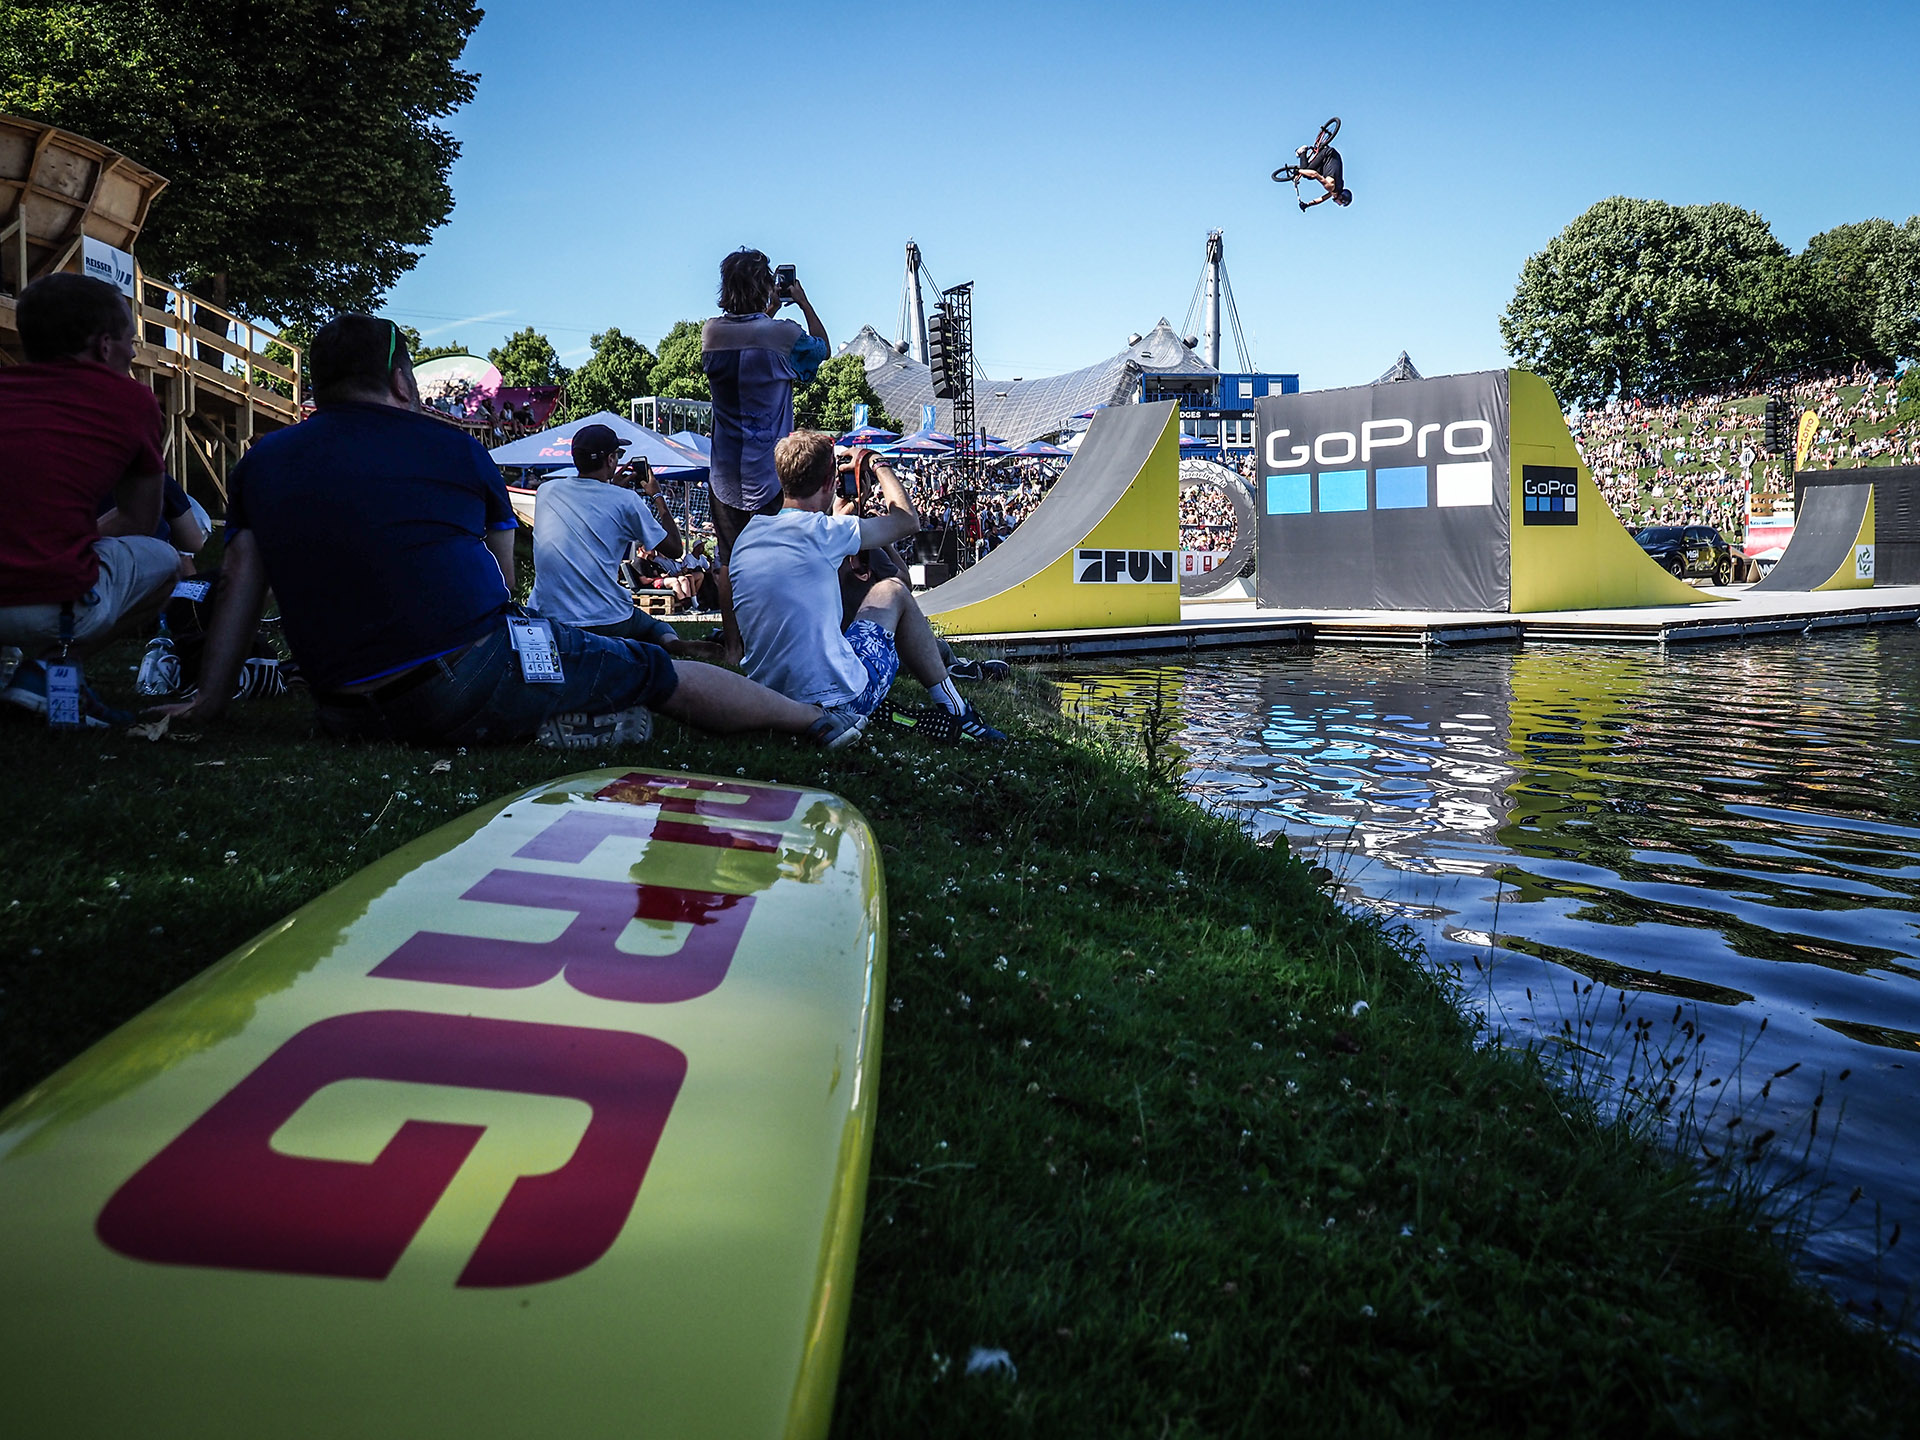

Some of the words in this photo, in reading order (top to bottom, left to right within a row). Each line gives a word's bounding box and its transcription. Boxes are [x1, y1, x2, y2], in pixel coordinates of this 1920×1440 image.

[85, 256, 112, 273] REISSER
[1801, 418, 1814, 444] LOTTO
[1265, 419, 1493, 468] GoPro
[1524, 479, 1576, 496] GoPro
